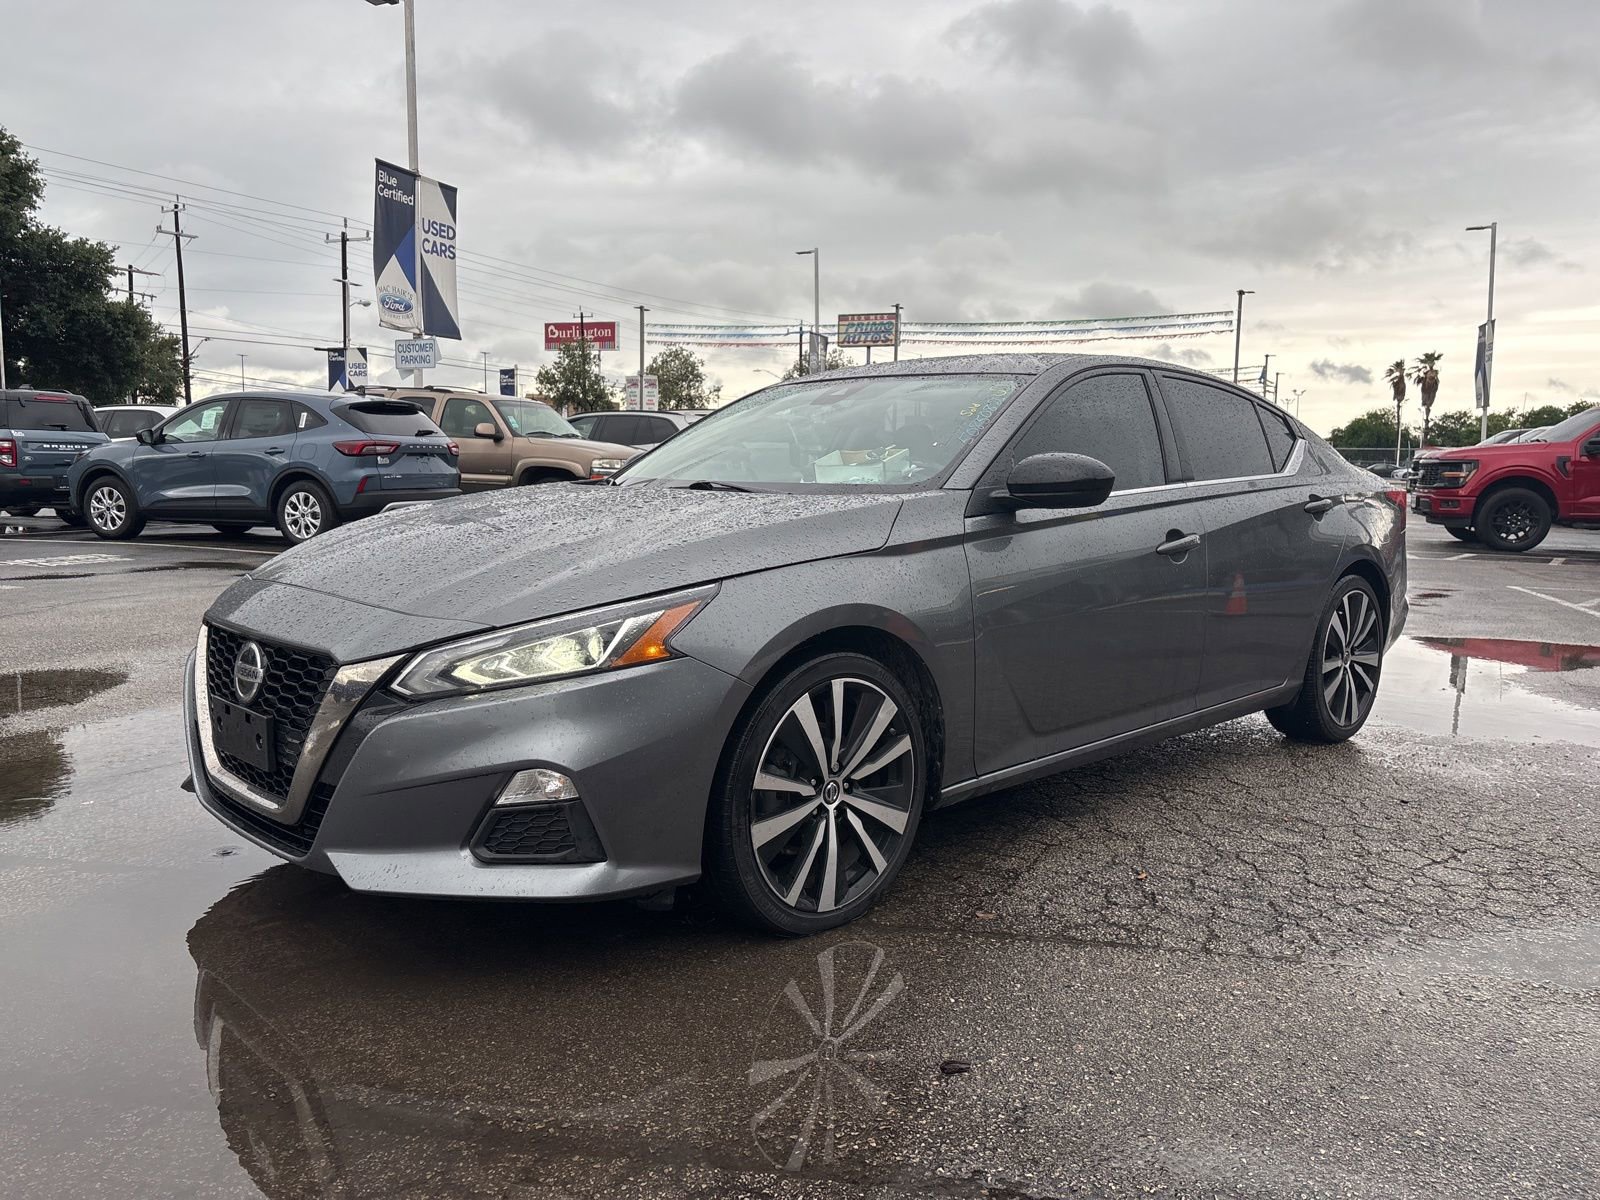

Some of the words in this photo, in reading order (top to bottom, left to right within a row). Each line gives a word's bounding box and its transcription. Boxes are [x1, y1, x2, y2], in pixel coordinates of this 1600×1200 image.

[378, 170, 398, 187] Blue
[377, 184, 414, 206] Certified
[422, 217, 456, 241] USED
[422, 238, 456, 260] CARS
[383, 296, 406, 311] Ford
[548, 325, 612, 341] Burlington
[397, 342, 434, 354] CUSTOMER
[348, 362, 367, 370] USED
[400, 354, 431, 365] PARKING
